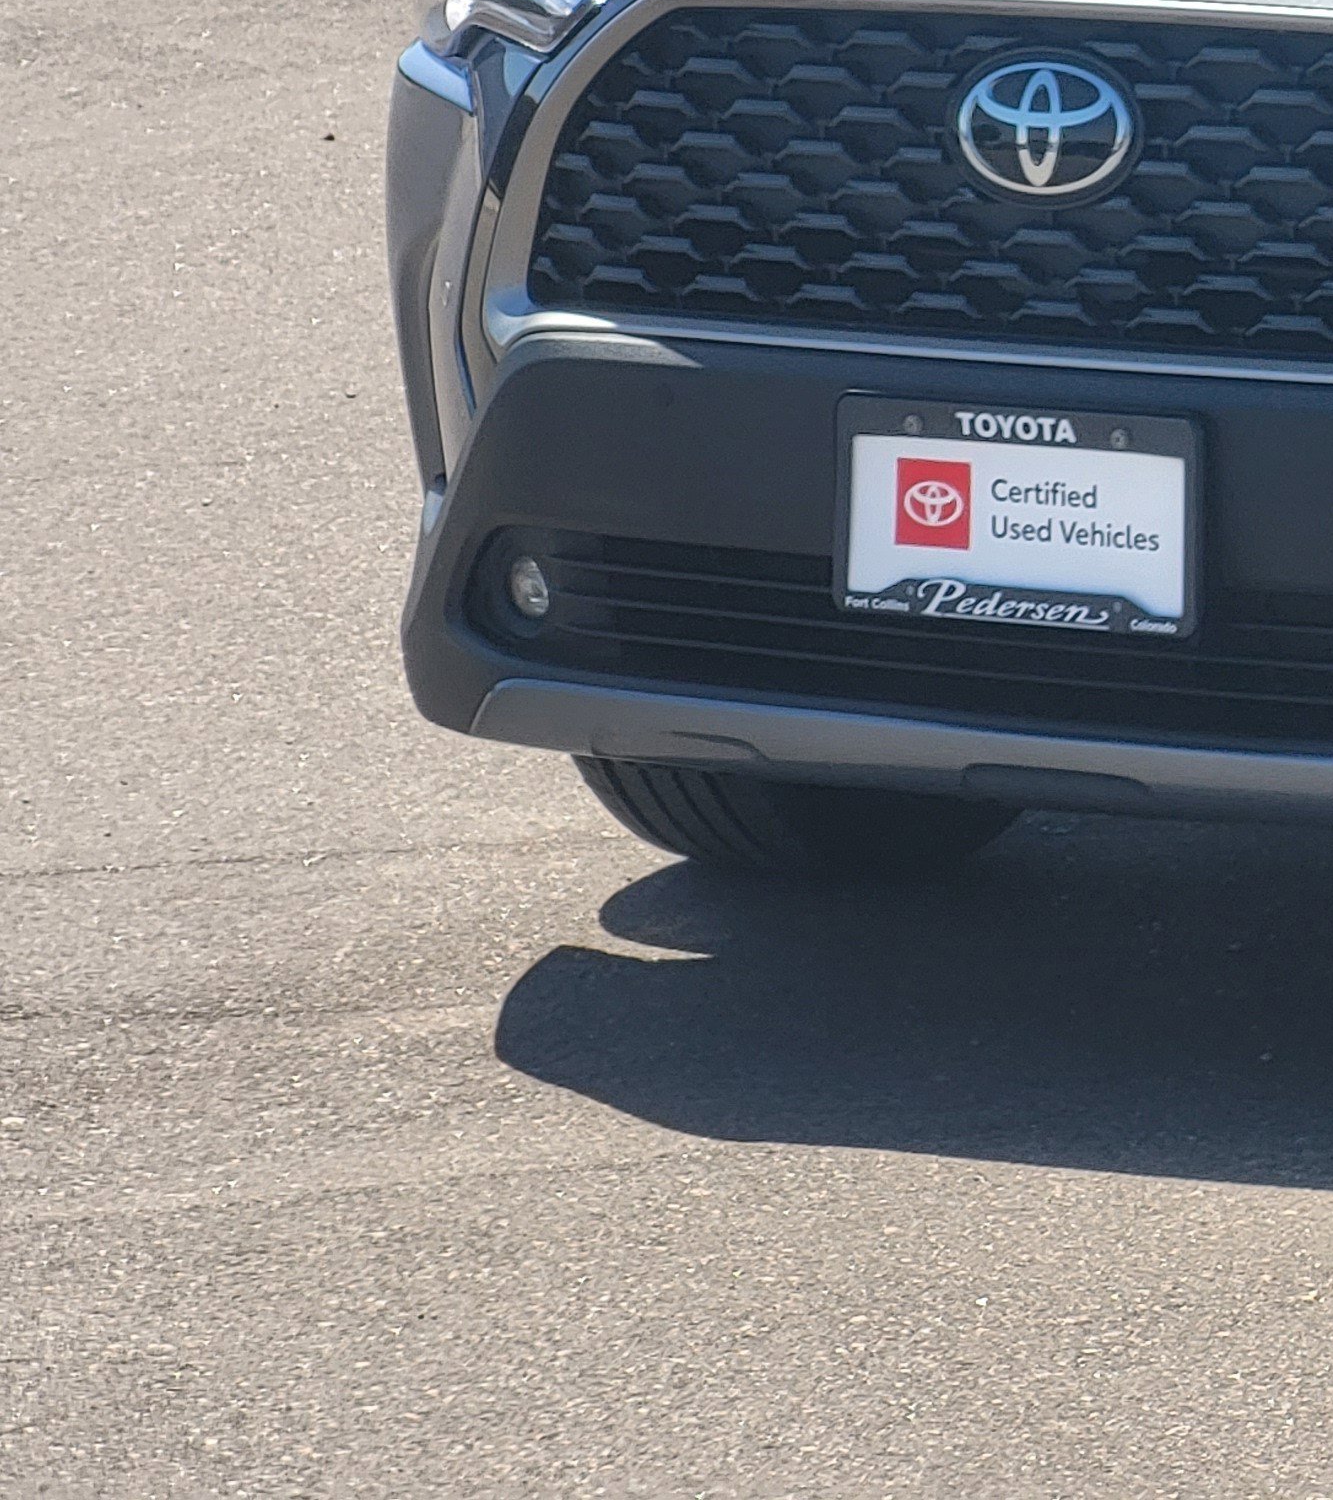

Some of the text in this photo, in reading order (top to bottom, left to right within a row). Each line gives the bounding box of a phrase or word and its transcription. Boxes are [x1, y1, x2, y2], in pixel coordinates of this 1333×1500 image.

[955, 411, 1077, 443] TOYOTA
[991, 478, 1097, 509] Certified
[991, 514, 1160, 552] Used Vehicles
[917, 578, 1109, 626] Pedersen
